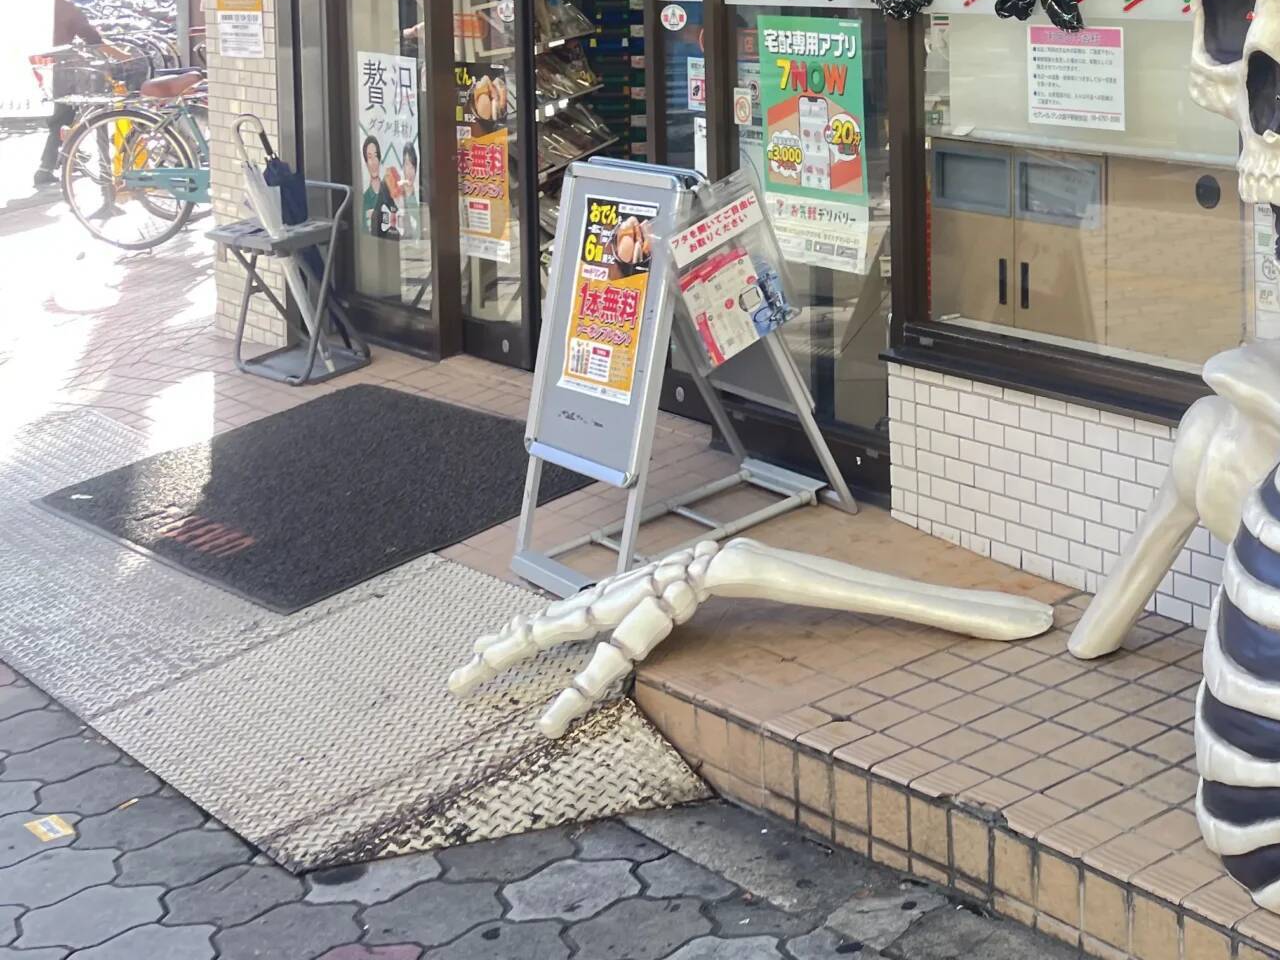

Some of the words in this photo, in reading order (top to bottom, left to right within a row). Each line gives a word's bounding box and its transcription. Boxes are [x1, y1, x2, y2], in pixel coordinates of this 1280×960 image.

[763, 28, 856, 59] 宅配専用アプリ
[362, 58, 415, 117] 贅沢
[776, 58, 848, 97] 7NOW
[671, 196, 756, 249] フタを開いてご自由に
[689, 213, 748, 253] お取りください
